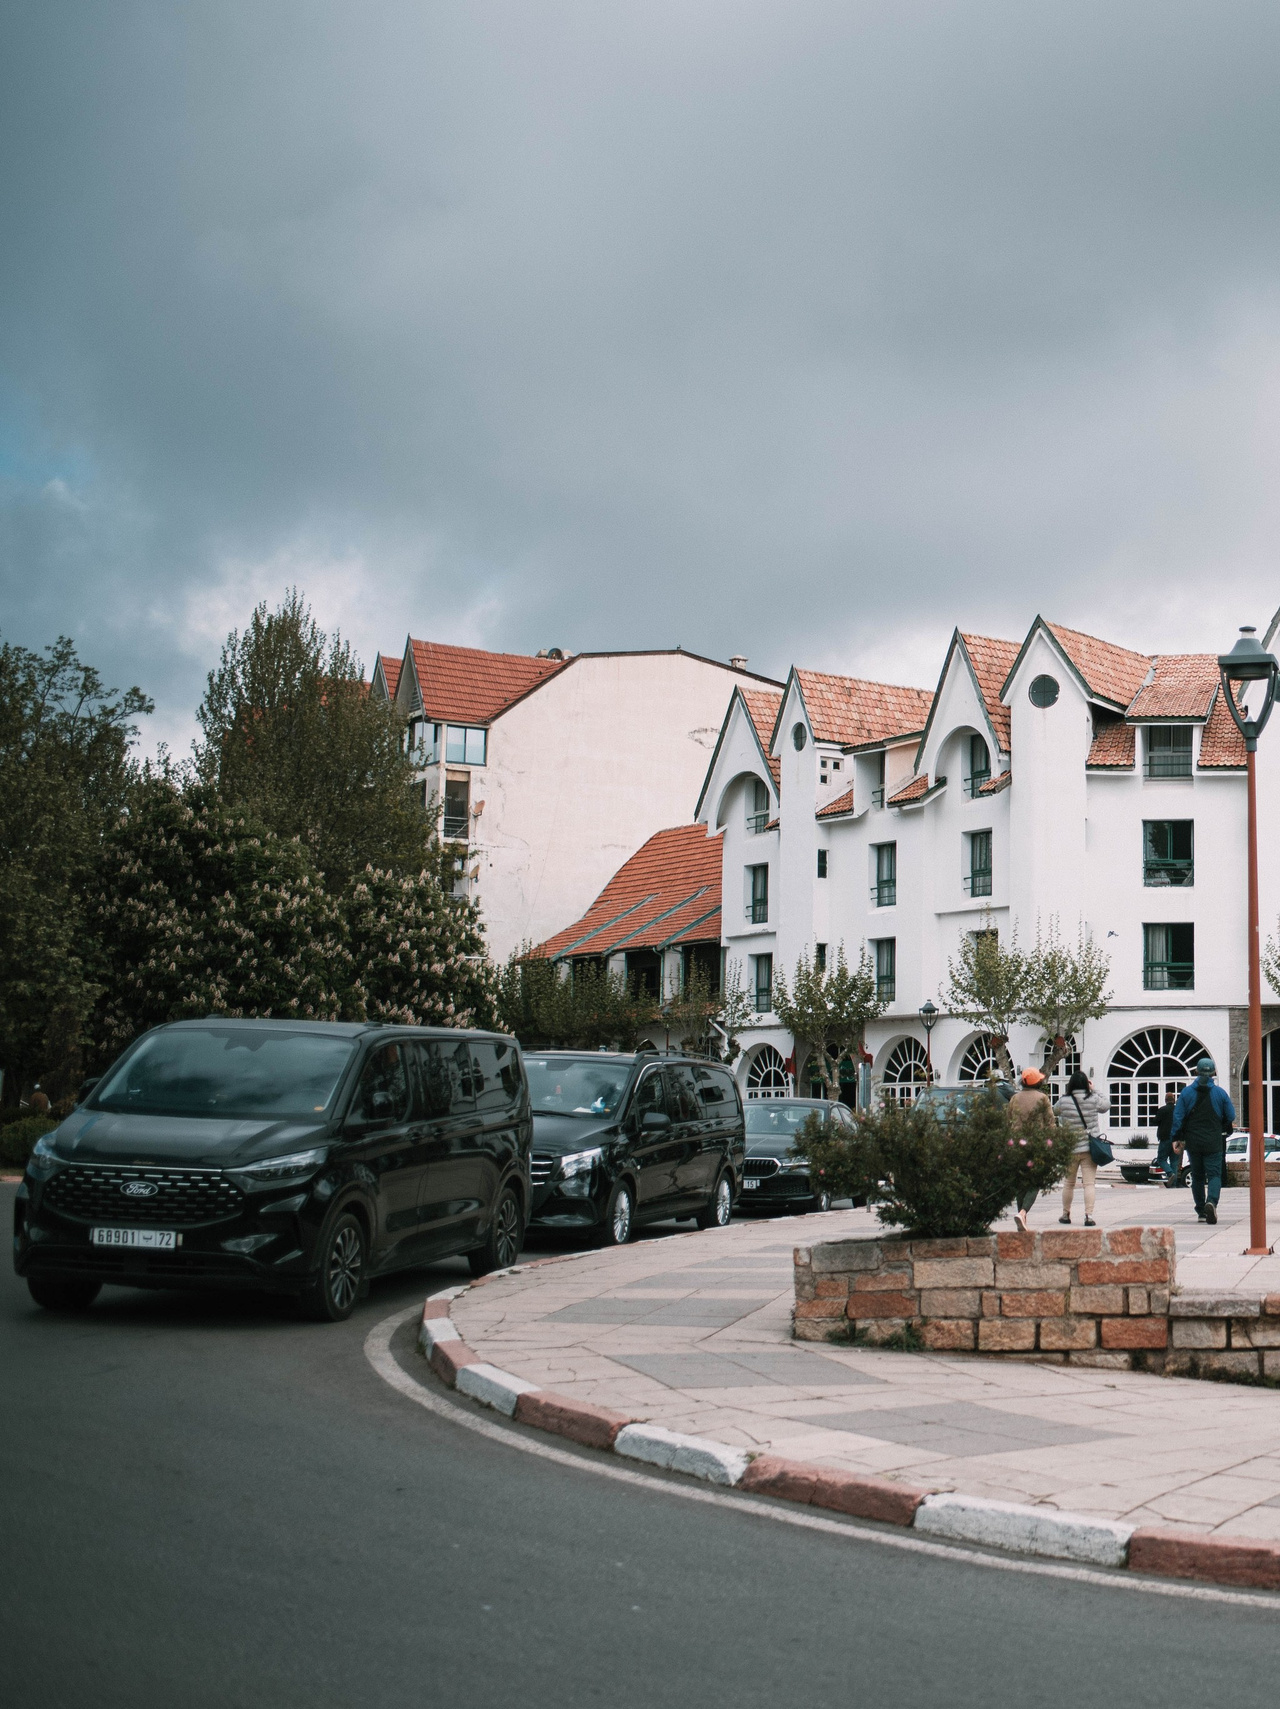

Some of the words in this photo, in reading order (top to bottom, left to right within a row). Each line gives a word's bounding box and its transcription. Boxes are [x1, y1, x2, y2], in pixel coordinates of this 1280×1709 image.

[126, 1183, 152, 1195] Ford
[97, 1229, 135, 1244] 68901
[159, 1232, 172, 1246] 72
